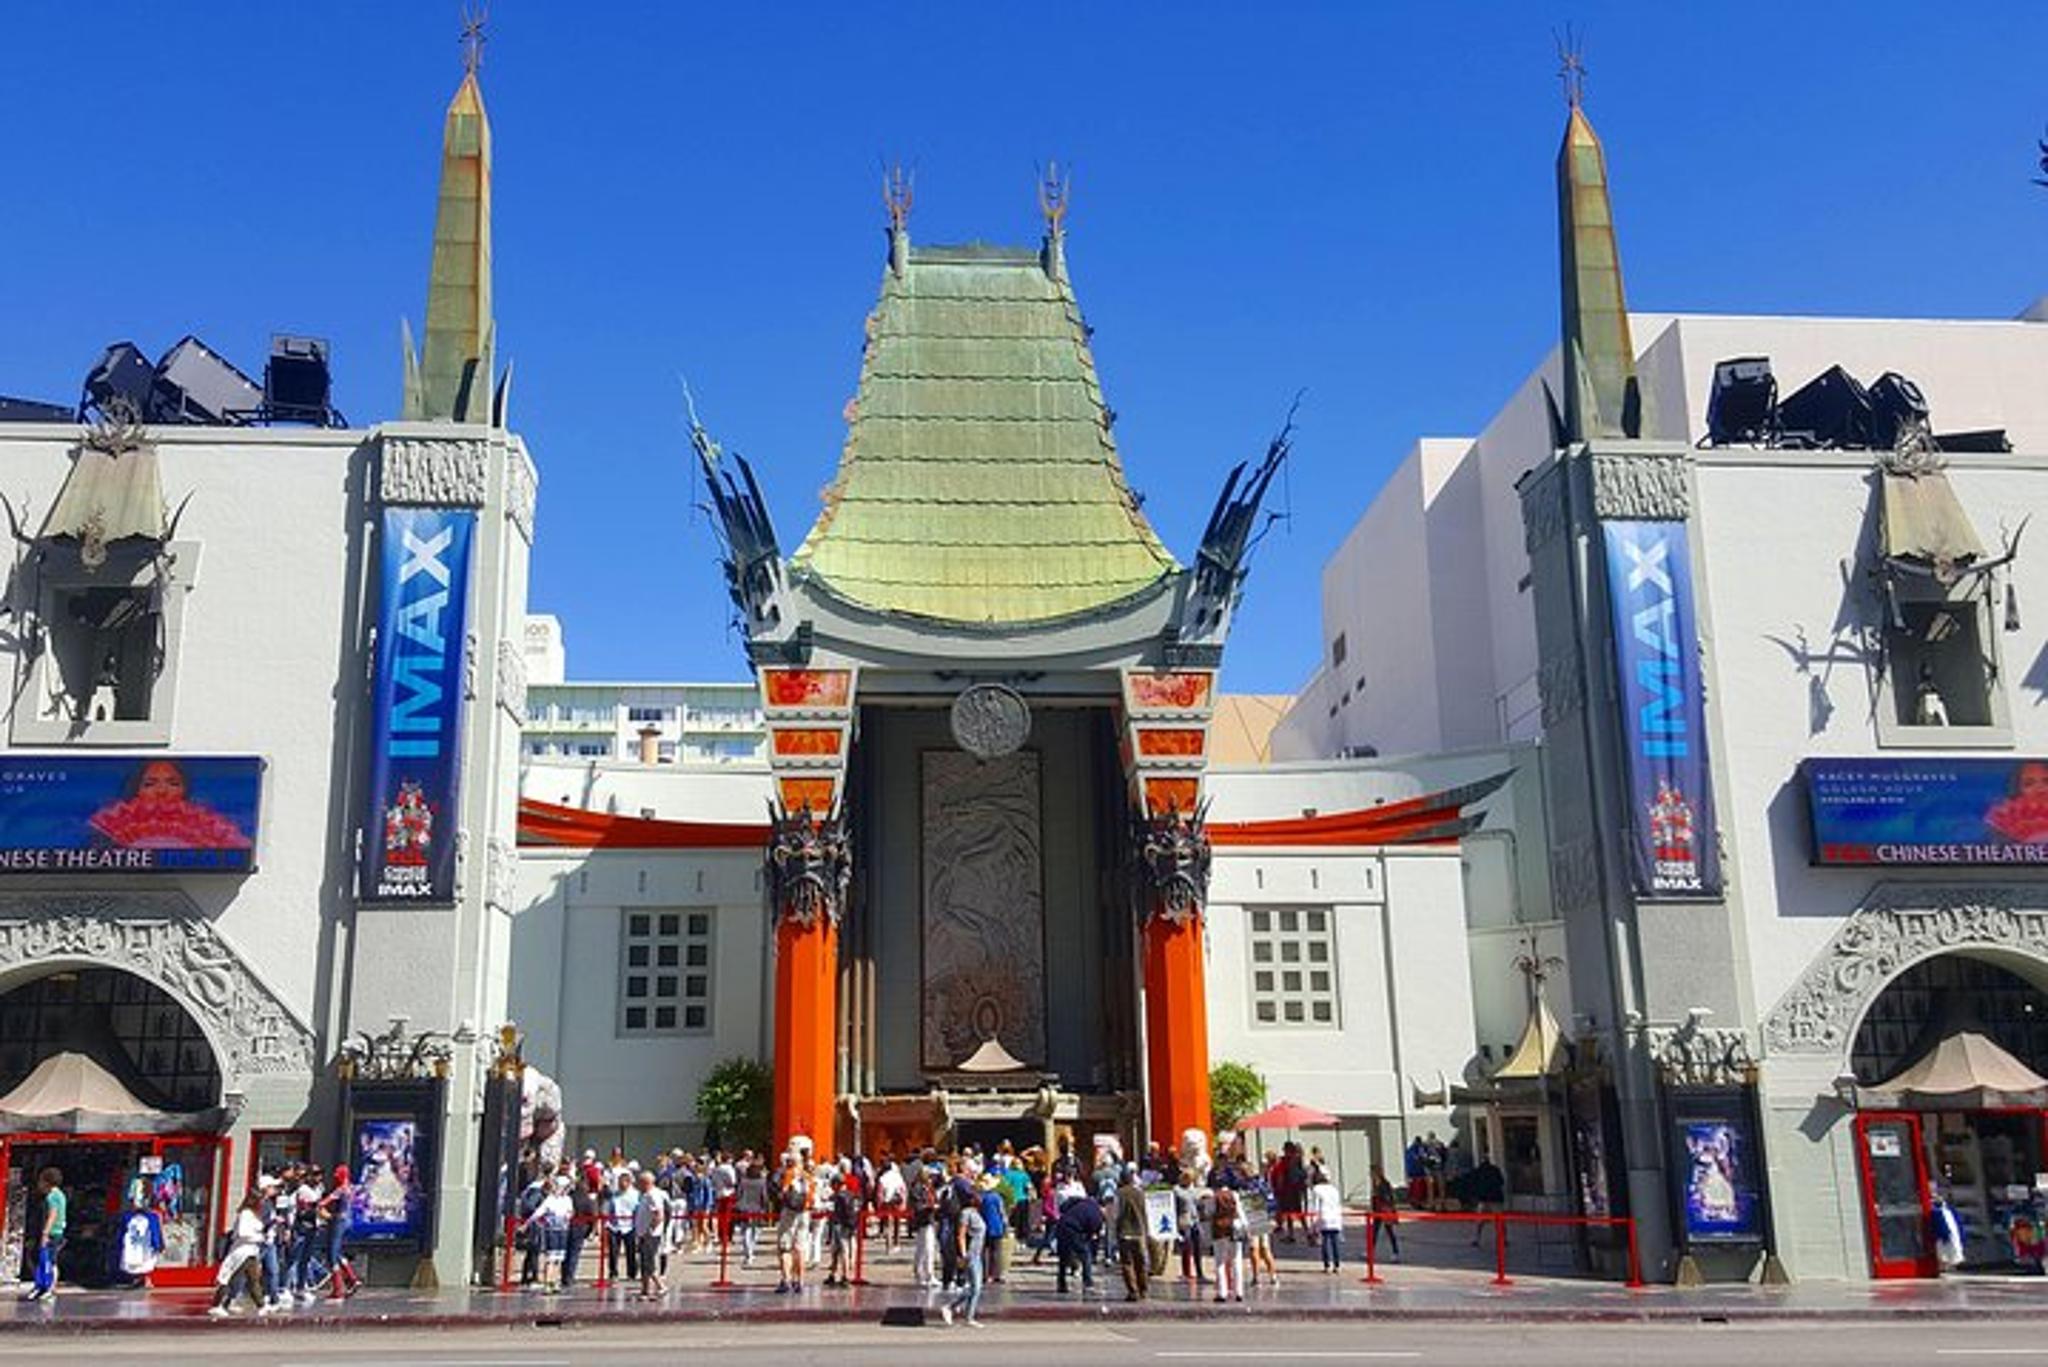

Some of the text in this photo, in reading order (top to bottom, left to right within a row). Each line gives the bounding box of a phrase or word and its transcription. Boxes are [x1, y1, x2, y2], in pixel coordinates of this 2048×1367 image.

[388, 524, 454, 758] IMAX
[1622, 538, 1688, 758] IMAX
[54, 850, 152, 867] THEATRE
[1876, 845, 1959, 861] CHINESE
[1961, 845, 2048, 861] THEATRE
[378, 883, 432, 896] IMAX
[1653, 877, 1702, 889] IMAX
